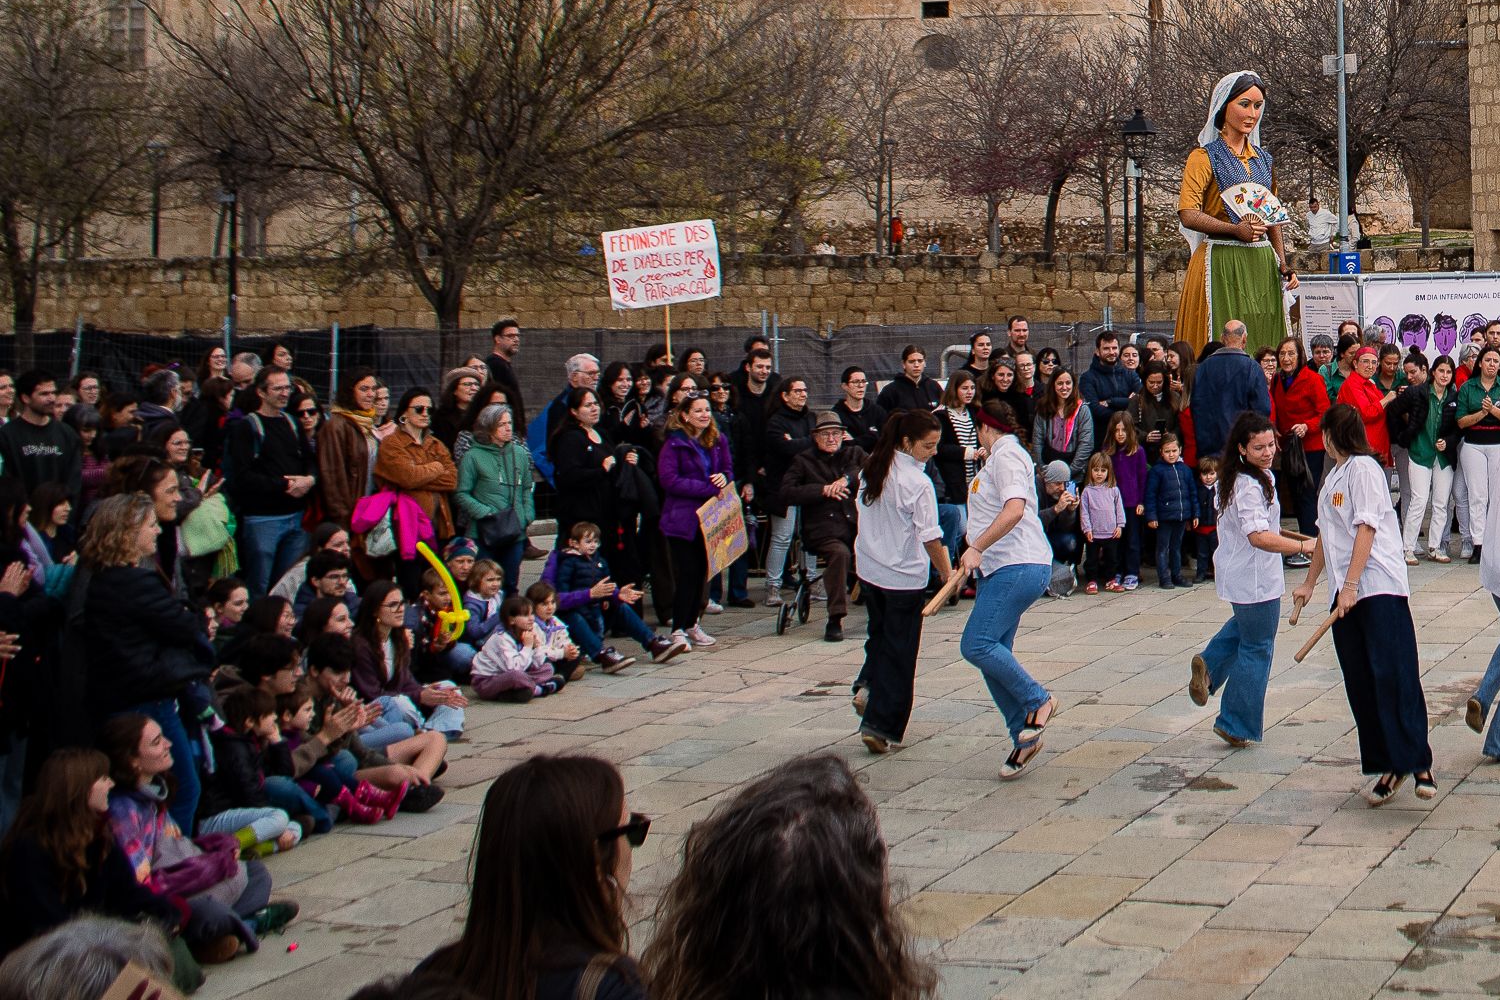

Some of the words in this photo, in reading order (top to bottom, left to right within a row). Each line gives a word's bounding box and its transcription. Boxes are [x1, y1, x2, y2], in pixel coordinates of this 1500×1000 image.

[610, 228, 676, 252] FEMINISME
[684, 225, 709, 243] DES
[611, 259, 629, 274] DE
[634, 252, 681, 269] DIABLES
[684, 250, 707, 265] PER
[635, 268, 694, 283] cremar
[623, 286, 636, 302] el
[1439, 292, 1491, 301] INTERNACIONAL
